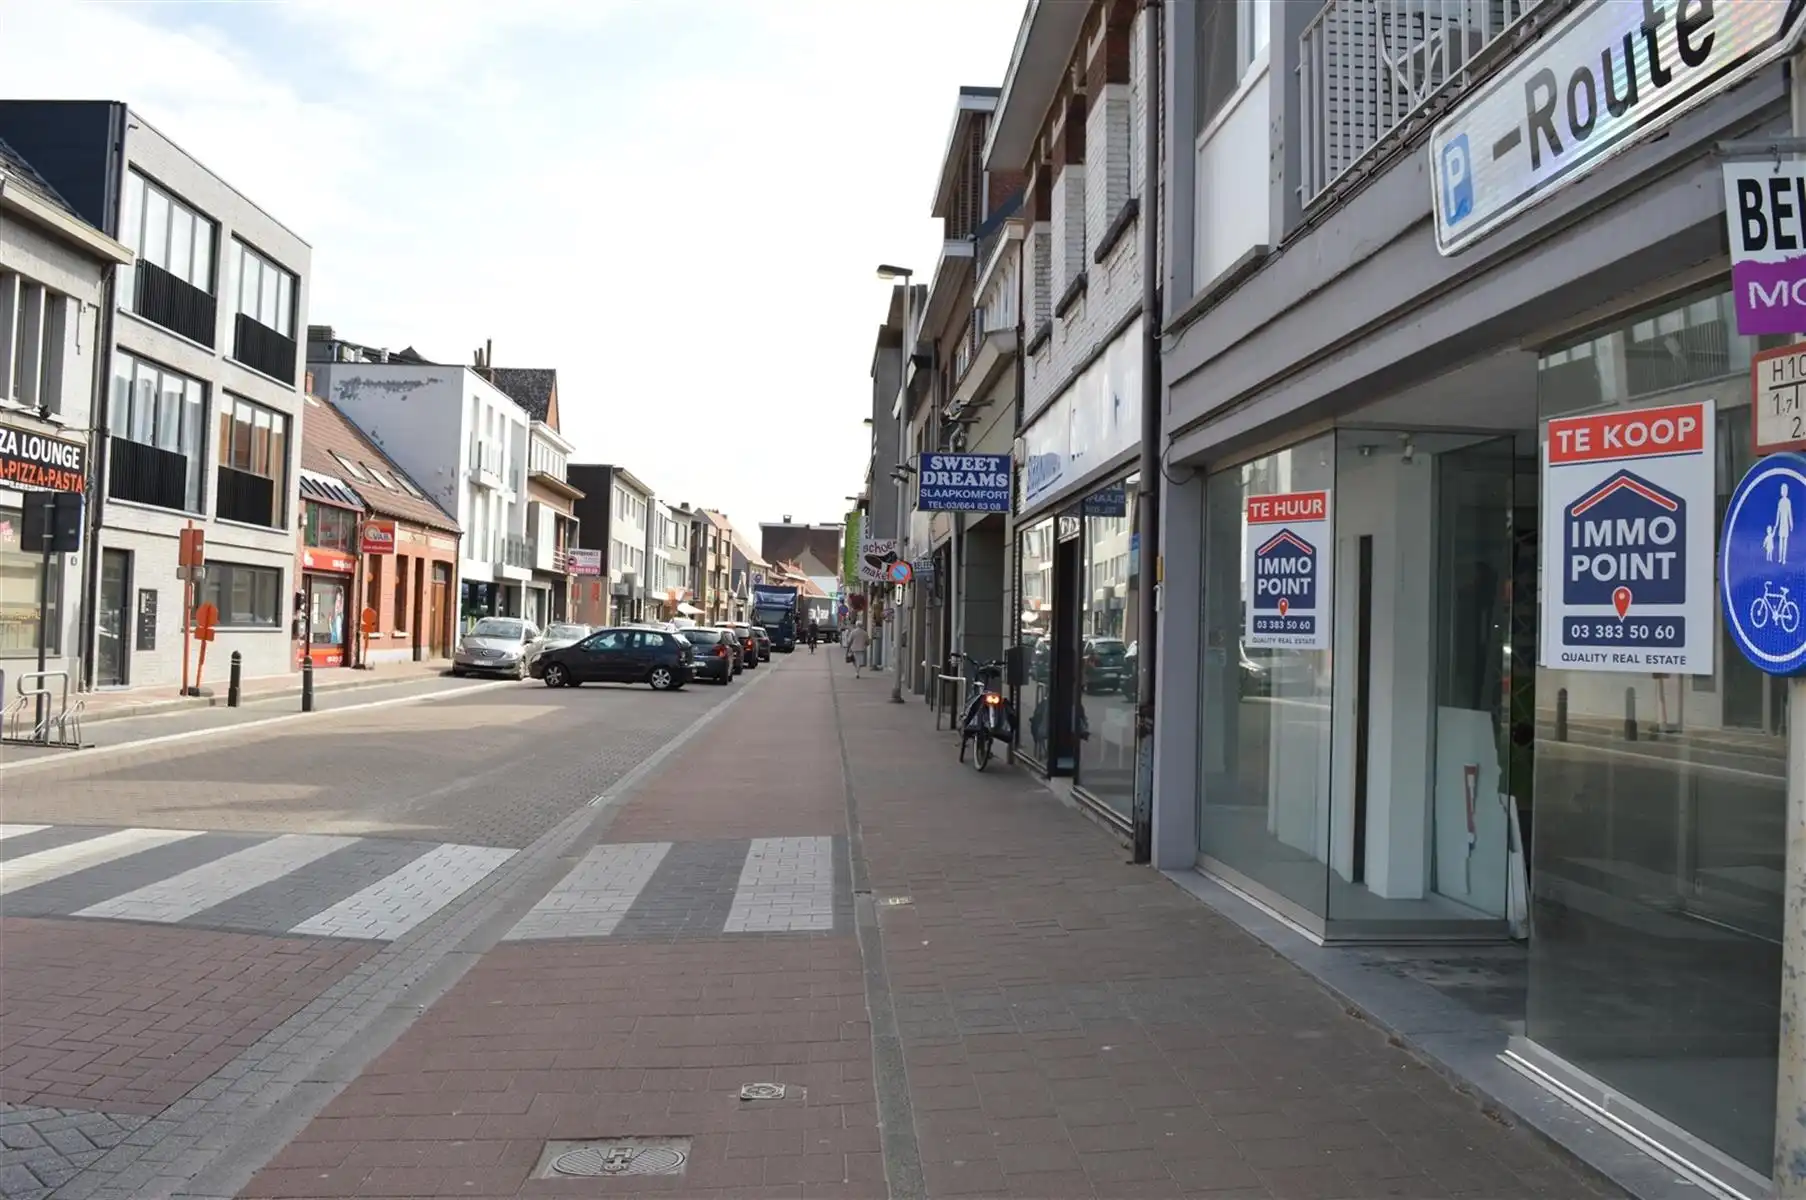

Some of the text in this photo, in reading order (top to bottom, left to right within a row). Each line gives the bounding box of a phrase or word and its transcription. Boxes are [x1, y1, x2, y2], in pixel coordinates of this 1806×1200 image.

[1556, 416, 1696, 454] TE KOOP
[21, 434, 81, 470] LOUNGE
[930, 455, 1000, 472] SWEET
[922, 471, 1009, 488] DREAMS
[920, 488, 1009, 500] SLAAPKOMFORT
[1250, 499, 1323, 518] TE HUUR
[1571, 516, 1677, 548] IMMO
[862, 565, 889, 580] make
[1257, 556, 1312, 575] IMMO
[1571, 551, 1677, 582] POINT
[1257, 577, 1312, 595] POINT
[1256, 620, 1311, 630] 03 383 50 60
[1571, 624, 1675, 640] 03 383 50 60
[1561, 652, 1687, 666] QUALITY REAL ESTATE
